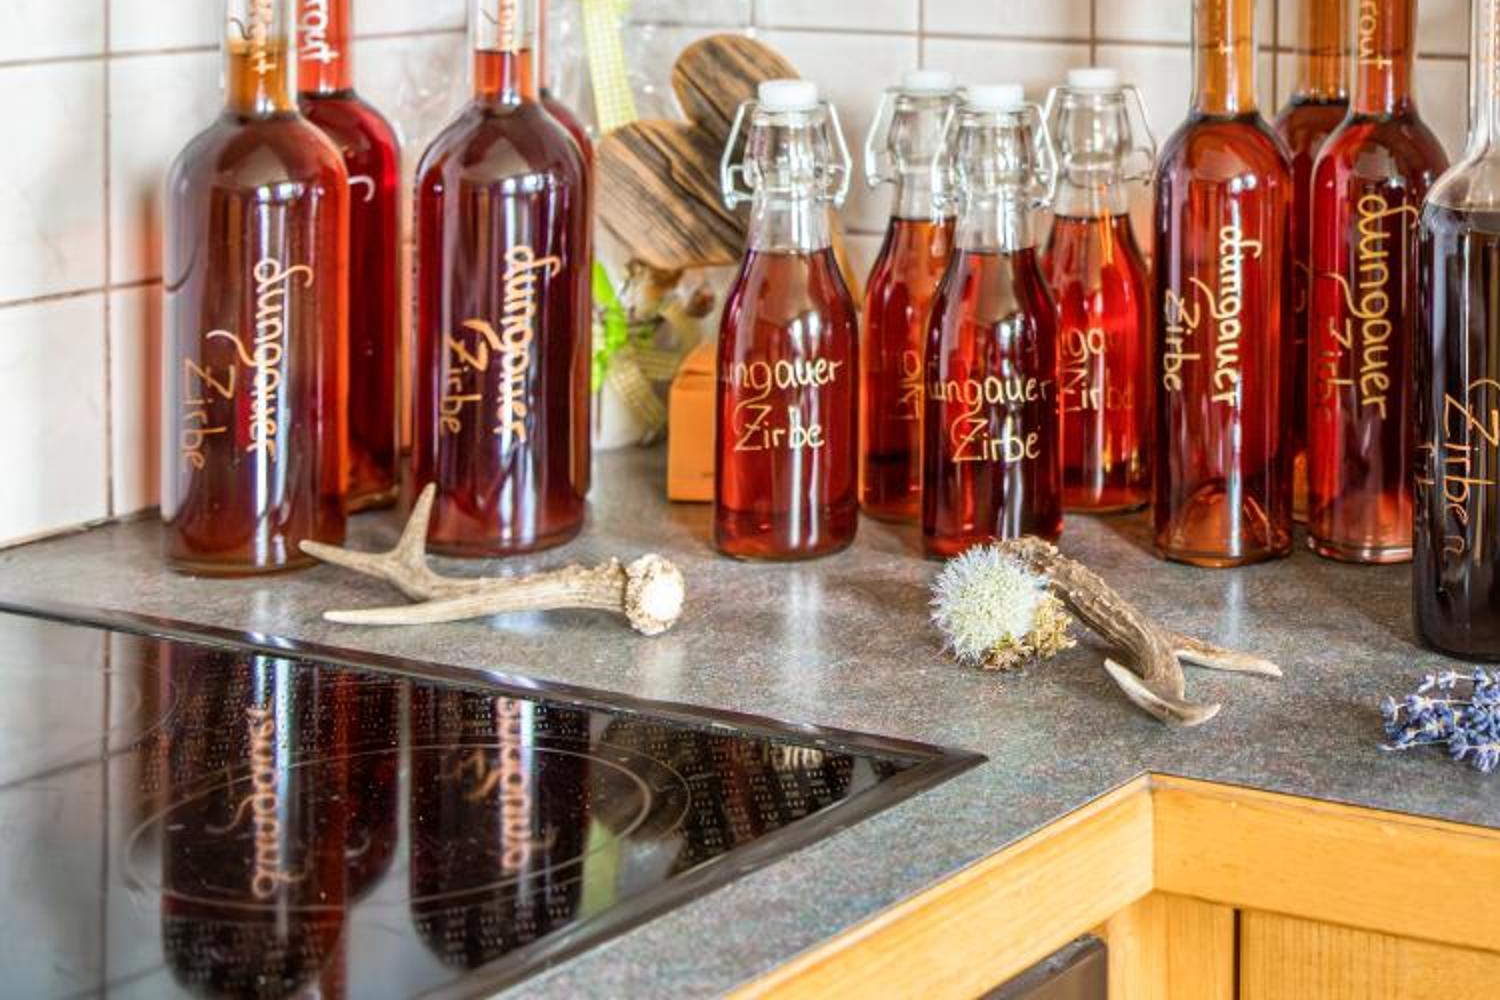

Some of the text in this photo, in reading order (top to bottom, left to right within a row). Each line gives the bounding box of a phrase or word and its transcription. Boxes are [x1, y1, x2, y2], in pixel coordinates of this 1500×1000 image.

[206, 258, 313, 462] Lungauer
[463, 246, 561, 443] Lungauer
[1163, 288, 1200, 391] Zirbe
[1189, 226, 1263, 407] Lungauer
[1326, 194, 1421, 420] Lungauer
[184, 358, 236, 470] Zirbe
[439, 333, 488, 436] Zirbe
[734, 405, 825, 451] Zirbe
[953, 415, 1041, 462] Zirbe
